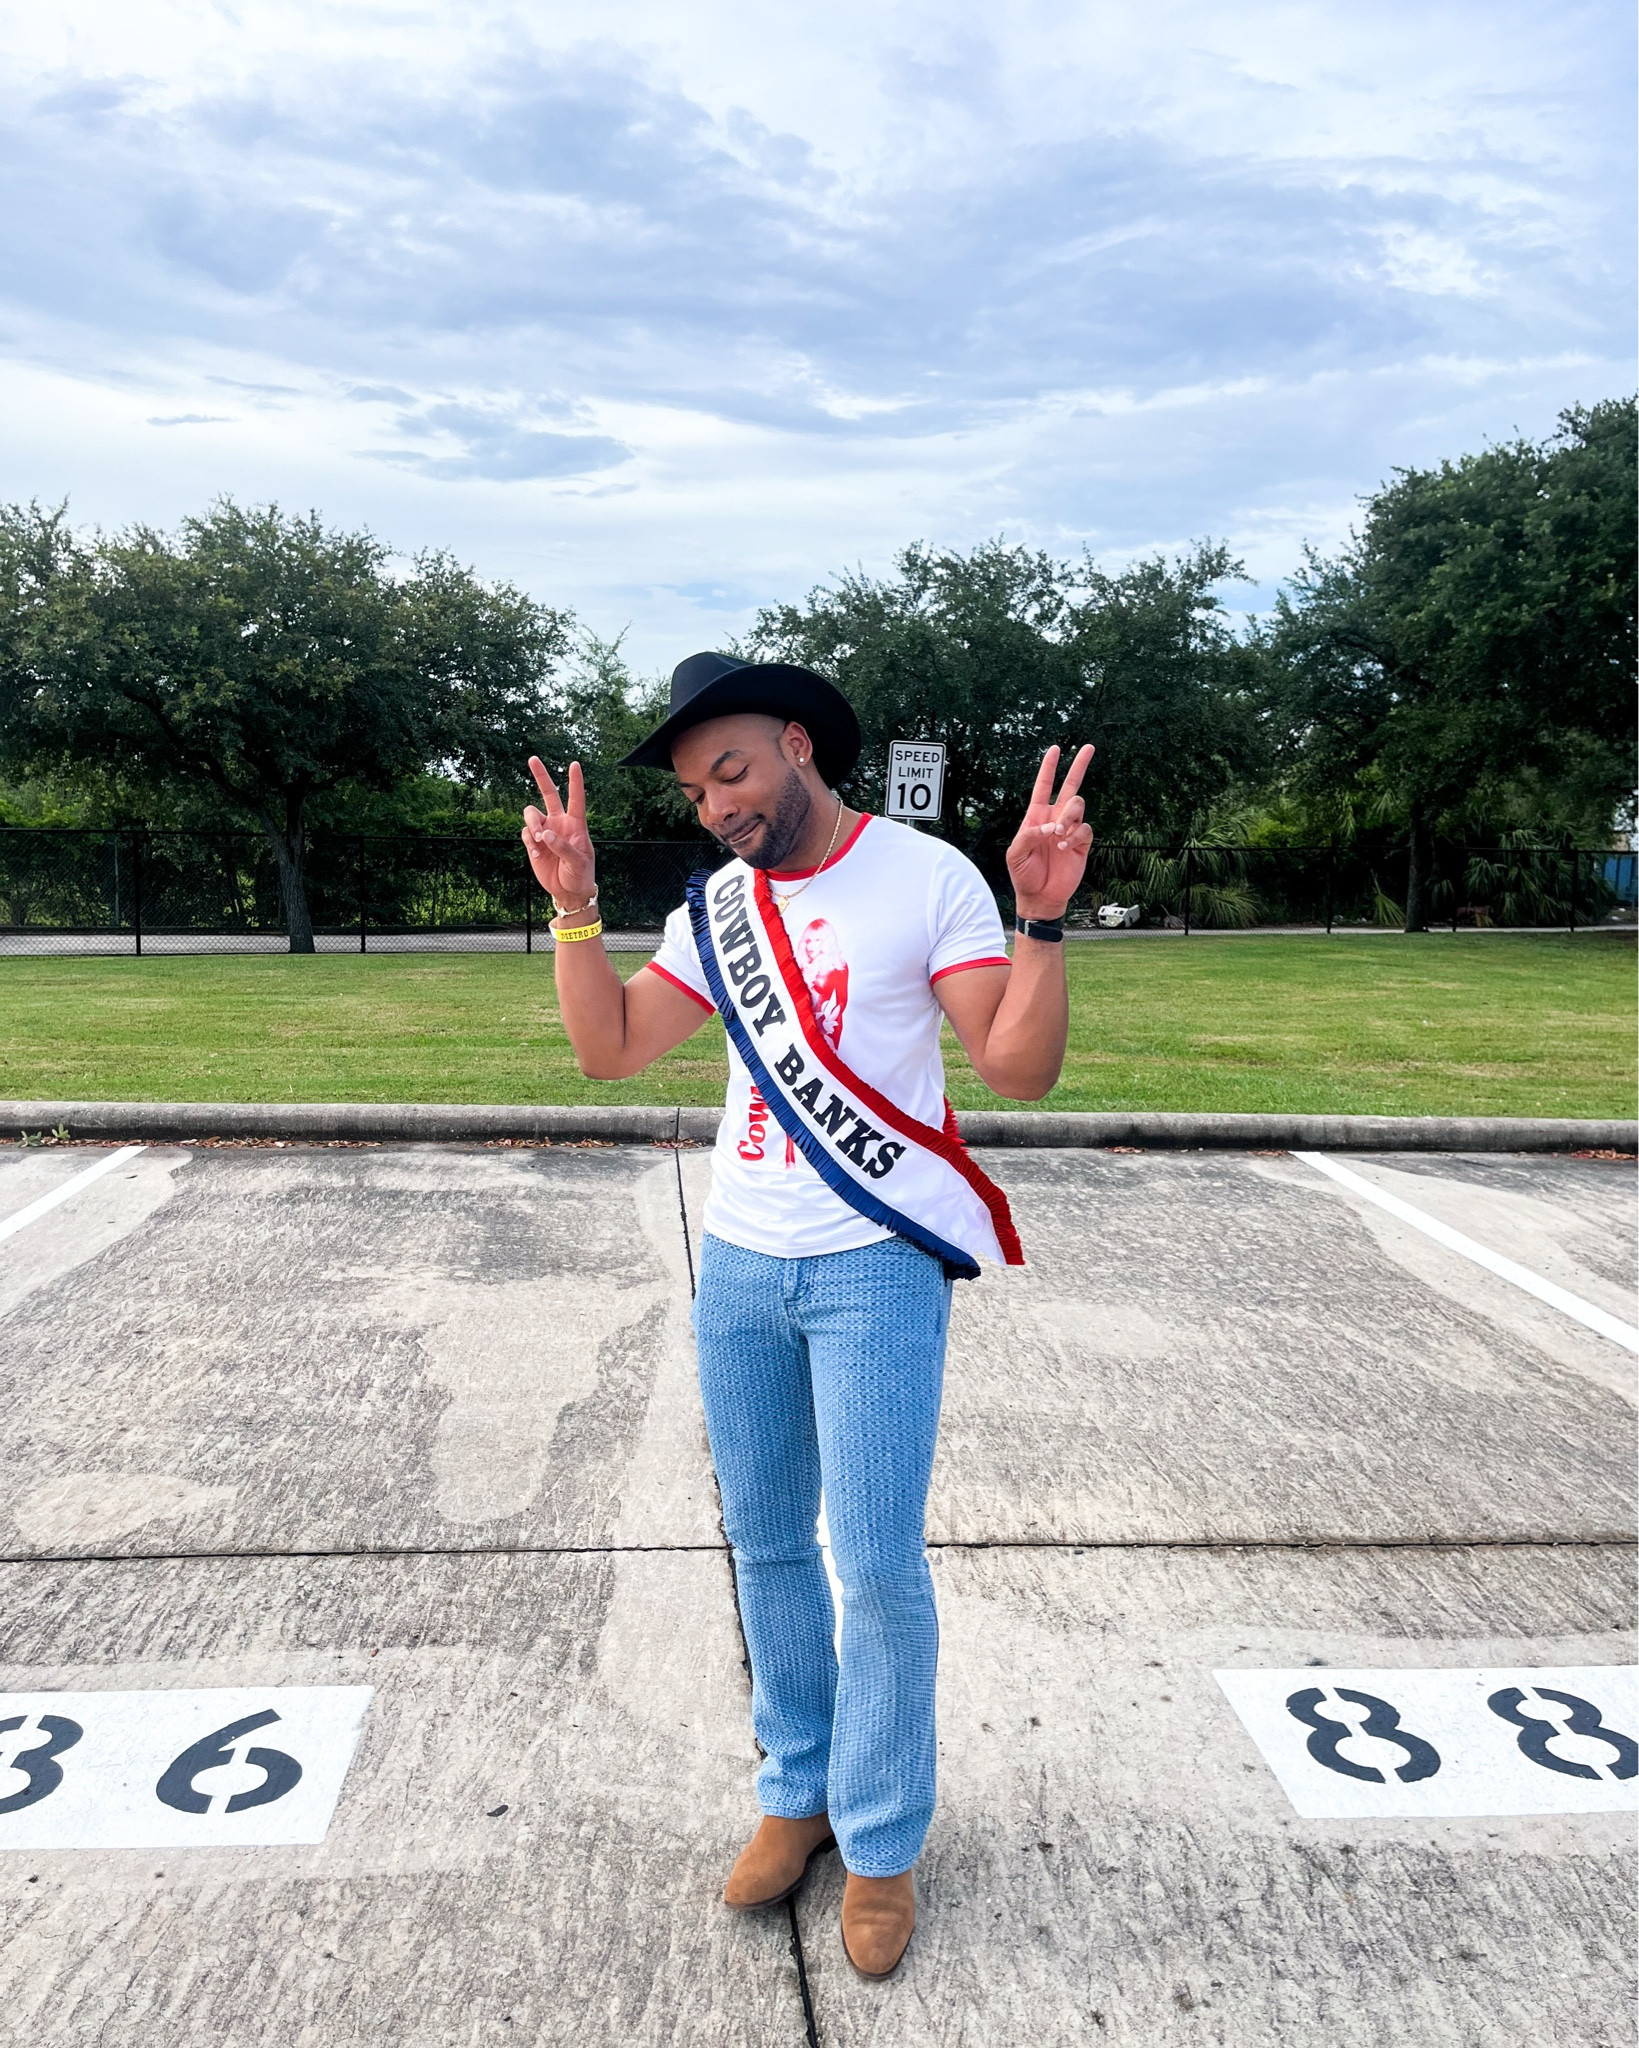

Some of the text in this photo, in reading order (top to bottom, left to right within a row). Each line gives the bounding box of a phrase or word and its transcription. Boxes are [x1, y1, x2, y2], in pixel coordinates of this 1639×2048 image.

[895, 750, 940, 763] SPEED
[898, 766, 934, 779] LIMIT
[897, 783, 931, 811] 10
[561, 930, 589, 940] METRO
[713, 874, 907, 1180] COWBOY BANKS
[1286, 1686, 1638, 1784] 88
